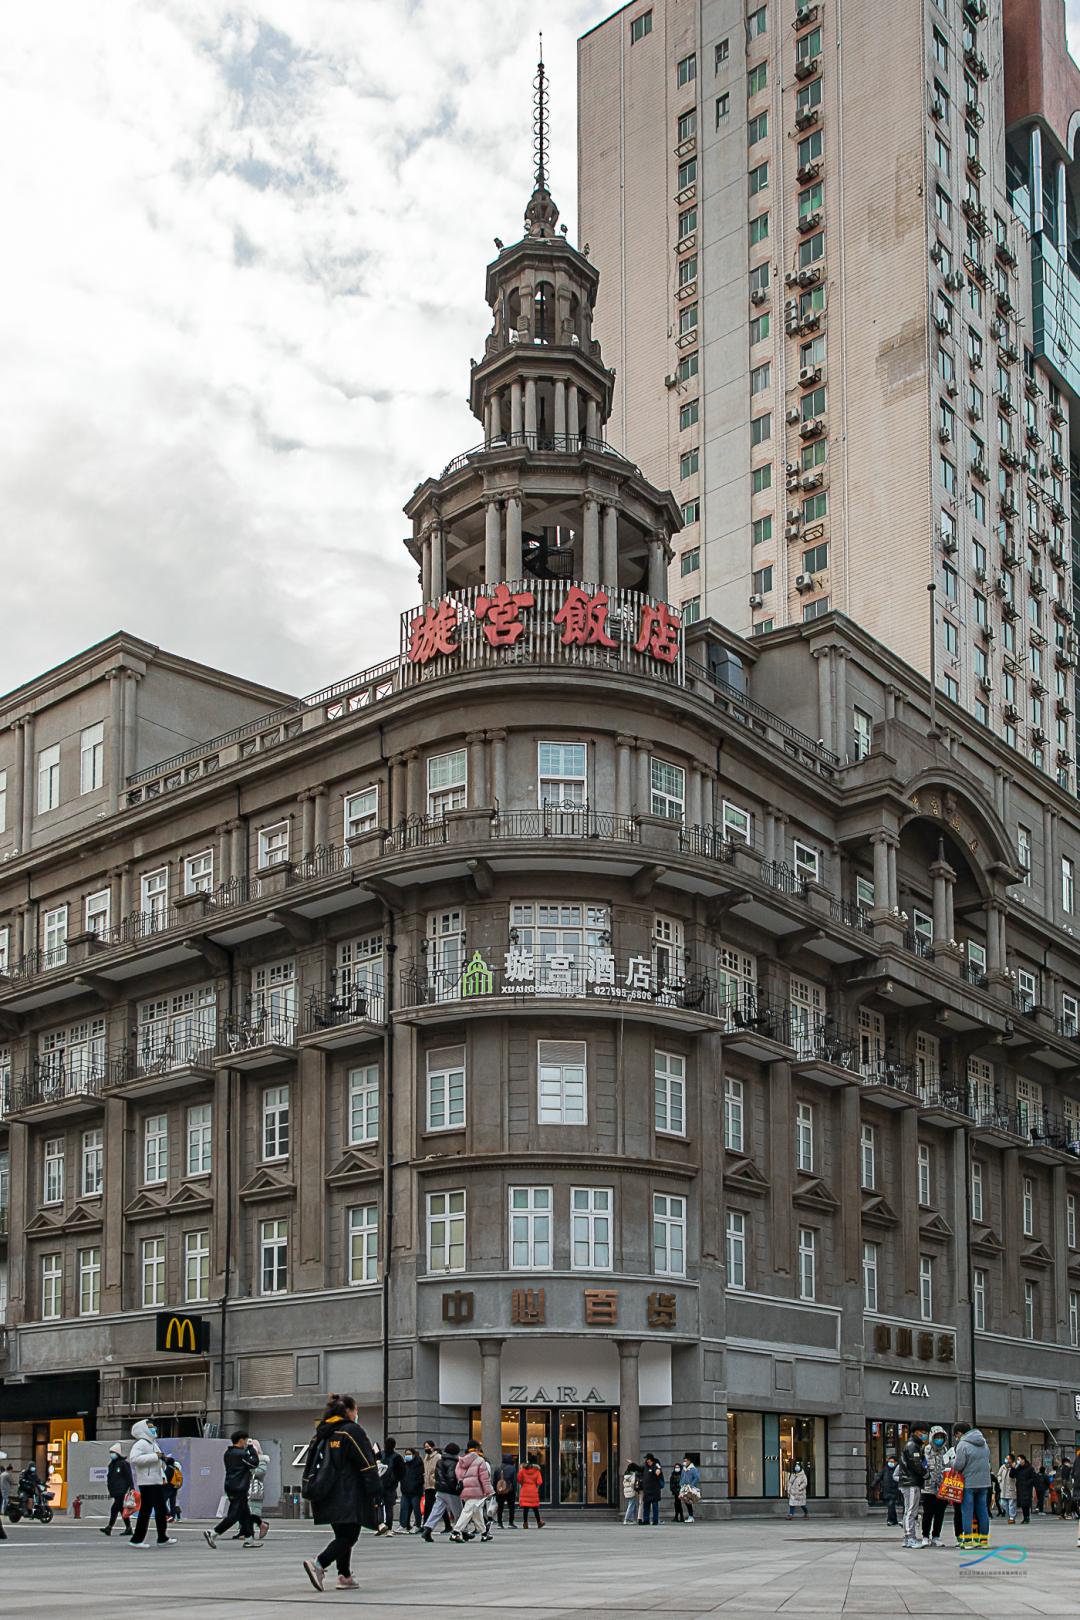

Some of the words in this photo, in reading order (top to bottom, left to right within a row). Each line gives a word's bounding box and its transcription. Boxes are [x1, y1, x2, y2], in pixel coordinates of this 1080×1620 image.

[441, 1287, 677, 1329] 中心百货
[508, 1385, 606, 1403] ZARA
[890, 1380, 931, 1398] ZARA
